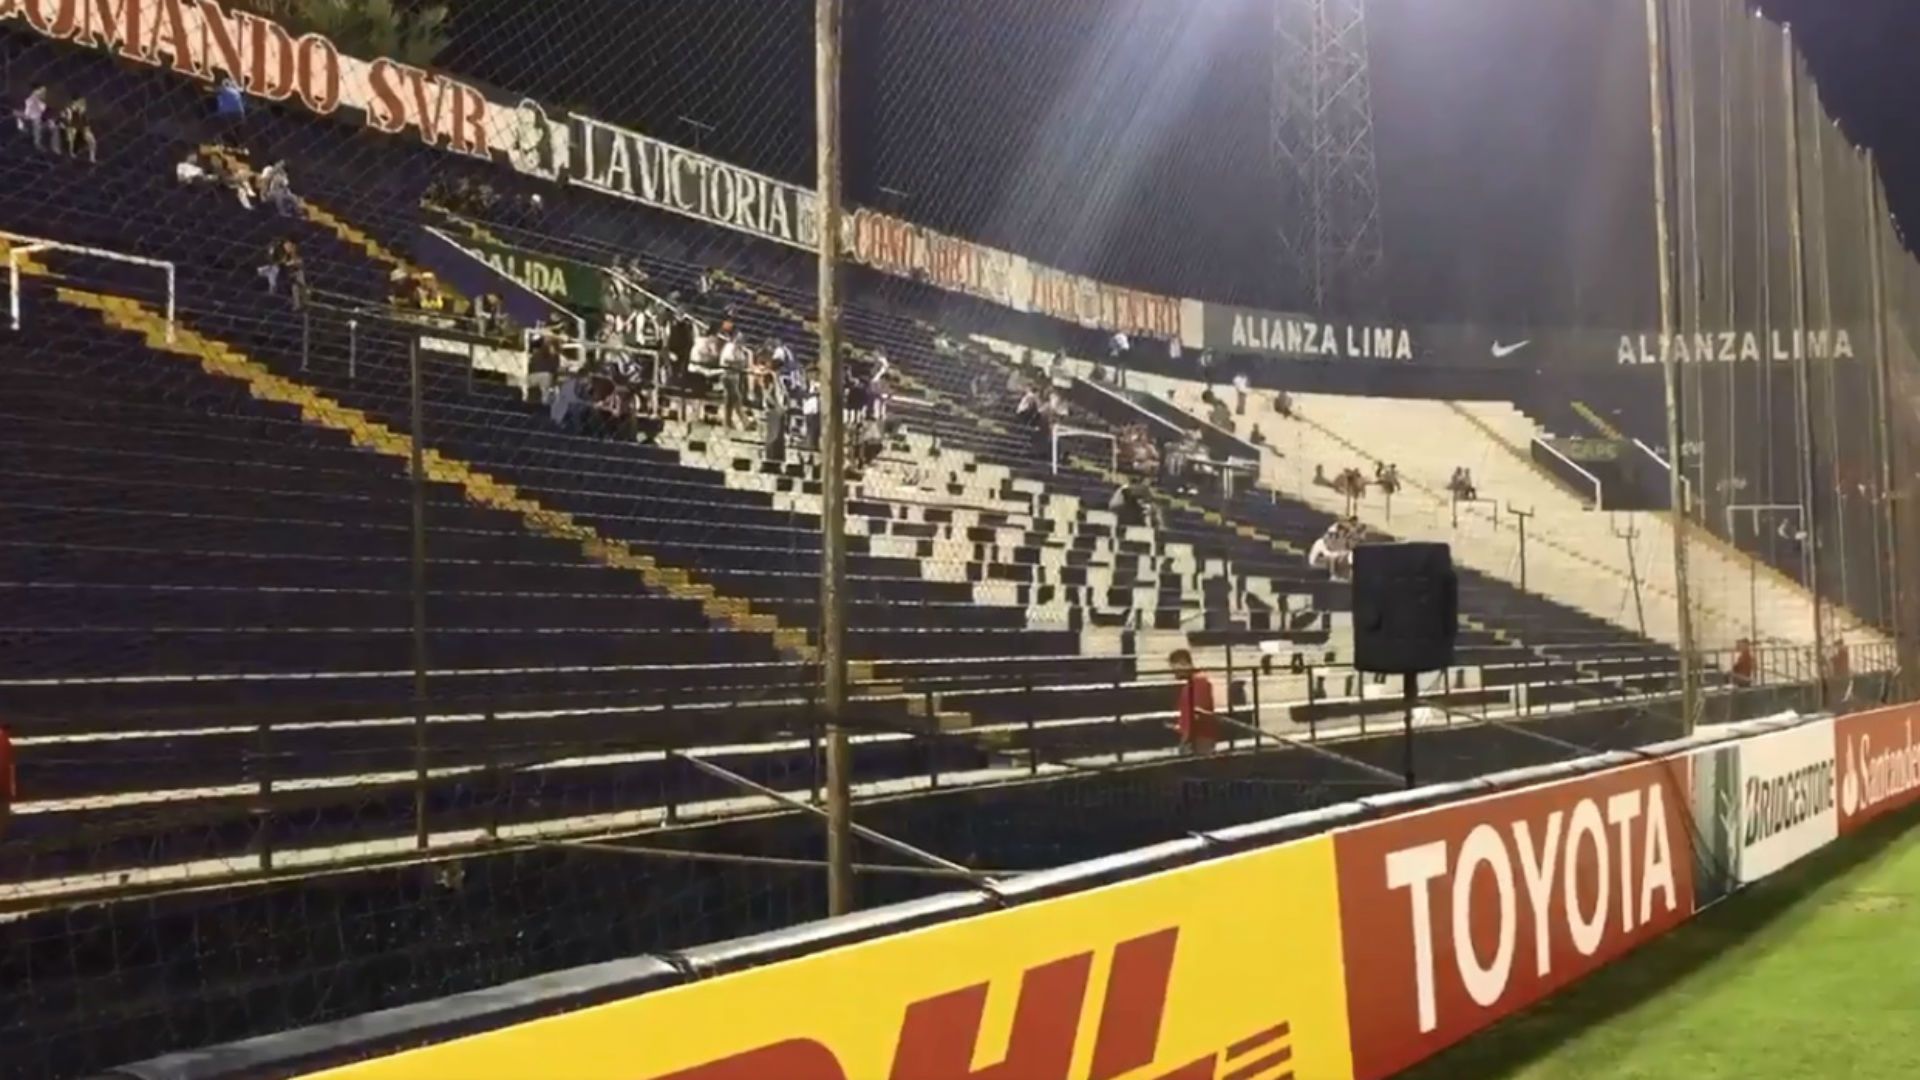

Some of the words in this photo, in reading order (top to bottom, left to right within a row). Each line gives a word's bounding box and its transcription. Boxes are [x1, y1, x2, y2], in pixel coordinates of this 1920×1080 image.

[0, 0, 341, 115] MANDO
[1232, 314, 1338, 355] ALIANZA
[1346, 325, 1412, 360] LIMA
[1617, 329, 1760, 364] ALIANZA
[1771, 328, 1854, 360] LIMA
[1744, 758, 1835, 848] BRIDGESTONE
[1385, 783, 1677, 1033] TOYOTA
[646, 926, 1218, 1080] HL
